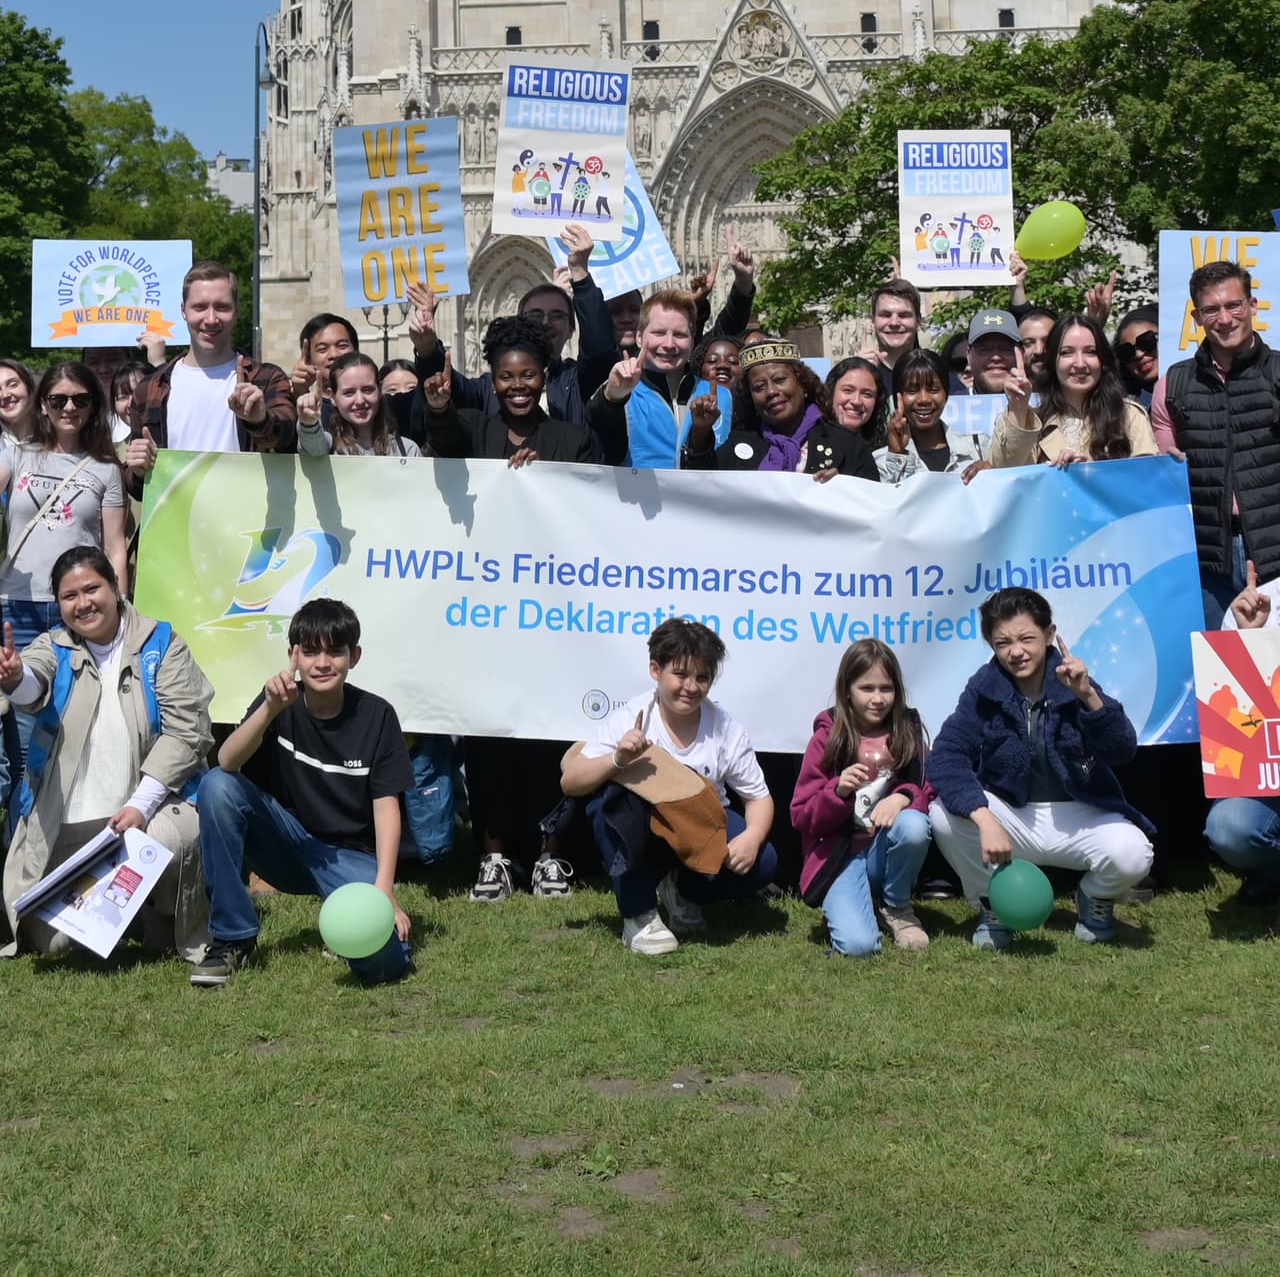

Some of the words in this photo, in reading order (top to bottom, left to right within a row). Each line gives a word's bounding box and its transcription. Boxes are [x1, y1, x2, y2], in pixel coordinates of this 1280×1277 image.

[513, 67, 622, 102] RELIGIOUS
[518, 100, 620, 134] FREEDOM
[362, 124, 429, 179] WE
[908, 144, 1003, 167] RELIGIOUS
[915, 172, 1002, 194] FREEDOM
[359, 182, 444, 241] ARE
[58, 271, 77, 306] VOTE
[69, 250, 96, 273] FOR
[98, 245, 161, 306] WORLDPEACE
[361, 242, 450, 302] ONE
[73, 308, 91, 322] WE
[97, 308, 121, 321] ARE
[125, 309, 150, 323] ONE
[366, 548, 501, 583] HWPL's
[512, 553, 801, 595] Friedensmarsch
[814, 571, 893, 598] zum
[904, 565, 954, 598] 12.
[964, 556, 1132, 594] Jubiläum
[445, 596, 508, 628] der
[732, 609, 799, 642] des
